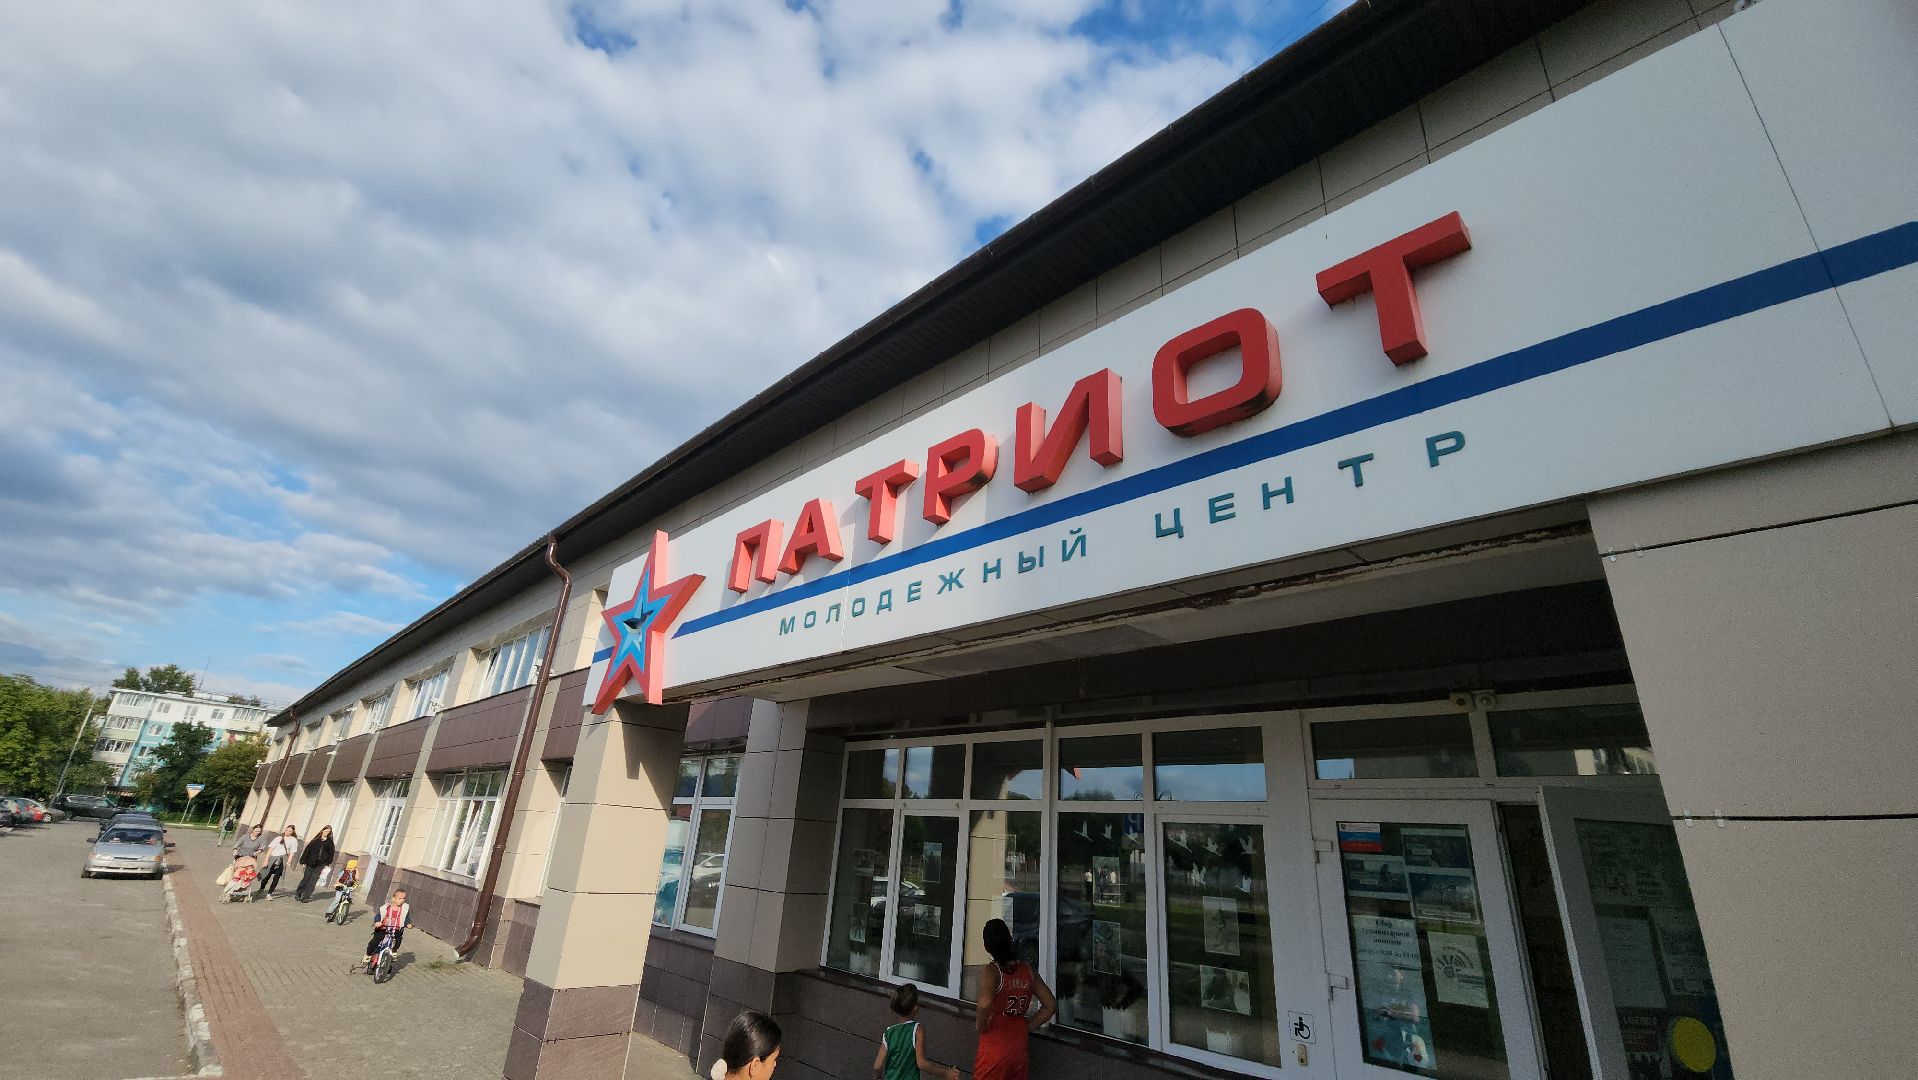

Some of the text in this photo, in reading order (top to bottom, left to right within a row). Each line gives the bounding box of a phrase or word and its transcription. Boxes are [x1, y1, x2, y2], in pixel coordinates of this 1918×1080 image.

[727, 210, 1473, 594] ПАТРИОТ
[778, 429, 1467, 637] МОЛОДЕЖНЫЙ ЦЕНТР
[1002, 995, 1028, 1017] 23
